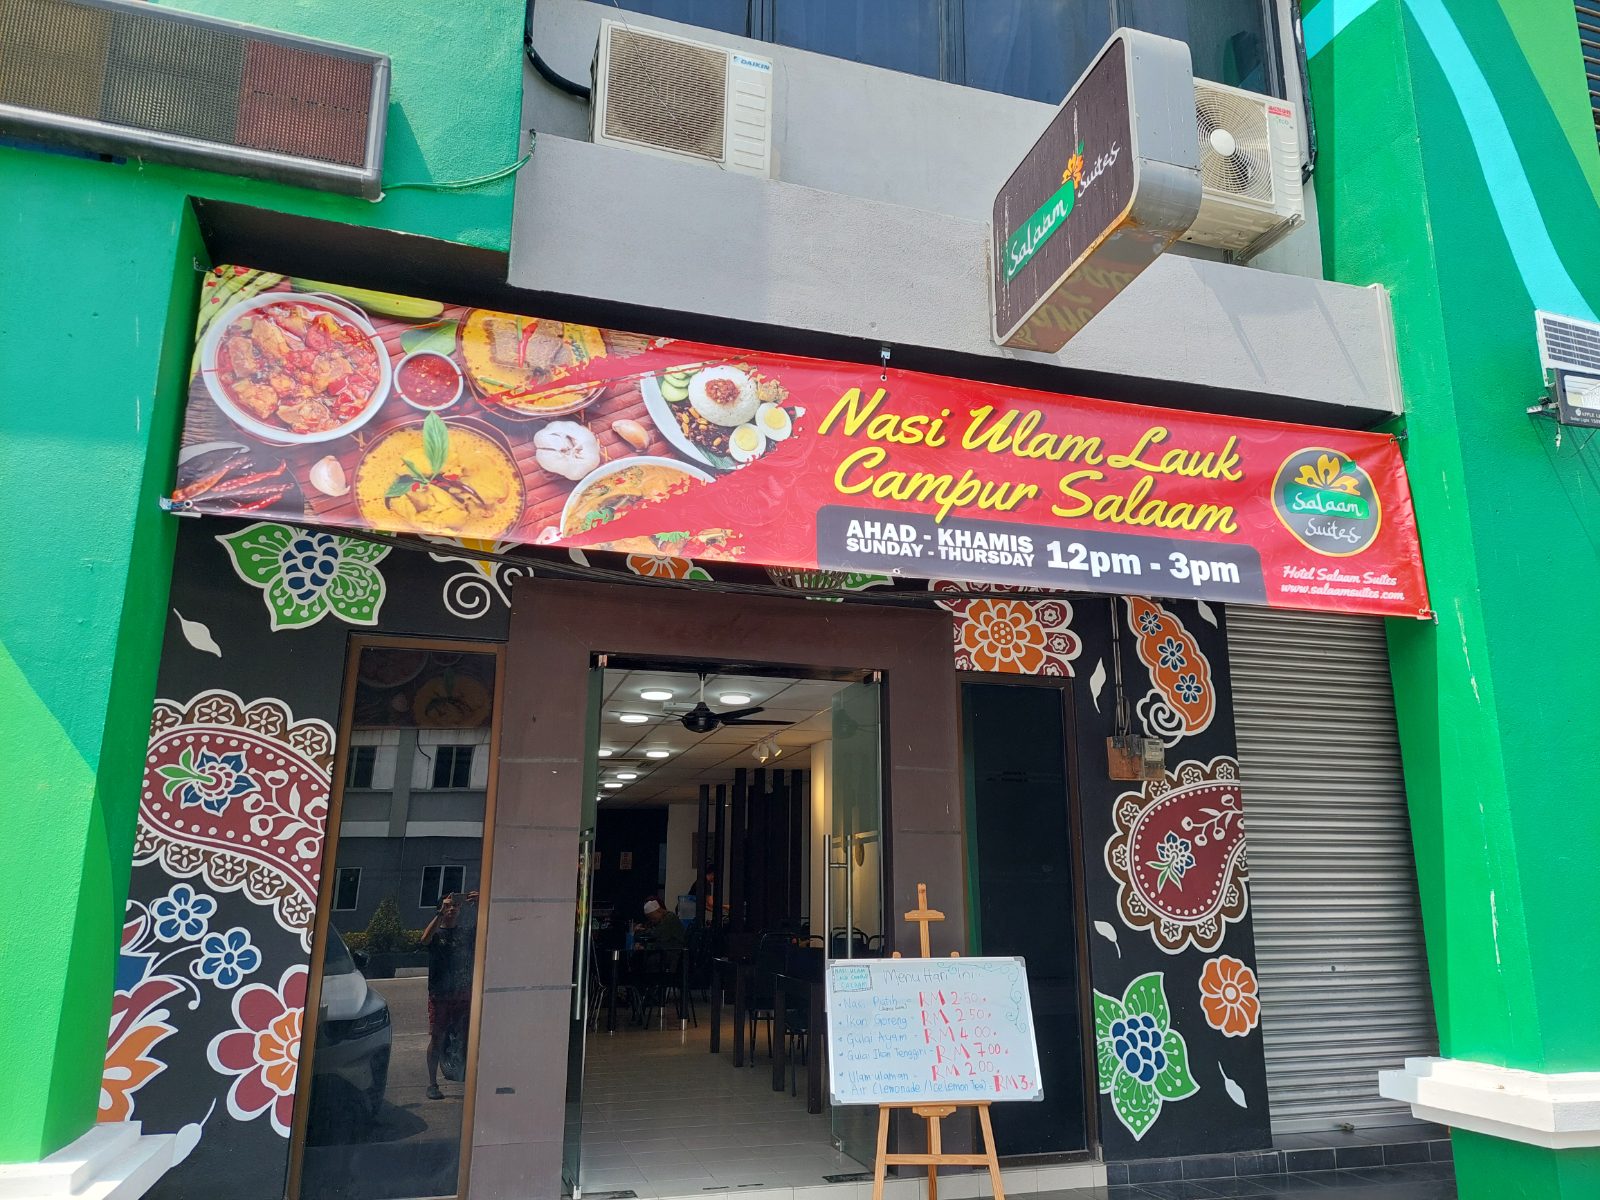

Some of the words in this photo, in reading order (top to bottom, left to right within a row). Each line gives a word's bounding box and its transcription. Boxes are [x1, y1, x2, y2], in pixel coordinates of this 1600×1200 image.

[740, 59, 770, 70] DAIKIN
[1078, 141, 1121, 198] Suites
[1008, 199, 1068, 275] Salaam
[817, 387, 951, 447] Nasi
[961, 405, 1104, 465] Ulam
[1107, 426, 1243, 481] Lauk
[833, 446, 1039, 524] Campur
[1051, 470, 1238, 534] Salaam
[1292, 492, 1364, 517] Salaam
[846, 519, 917, 543] AHAD
[937, 528, 1034, 553] KHAMIS
[1305, 518, 1362, 543] Suites
[846, 538, 923, 557] SUNDAY
[937, 546, 1035, 567] THURSDAY
[1046, 540, 1142, 577] 12pm
[1168, 552, 1241, 586] 3pm
[1282, 565, 1315, 580] Hotel
[1316, 568, 1361, 584] Salaam
[1363, 572, 1398, 586] Suites
[1280, 583, 1405, 601] www.salaamsuites.com
[883, 968, 920, 985] Menu
[874, 1013, 907, 1029] Goreng
